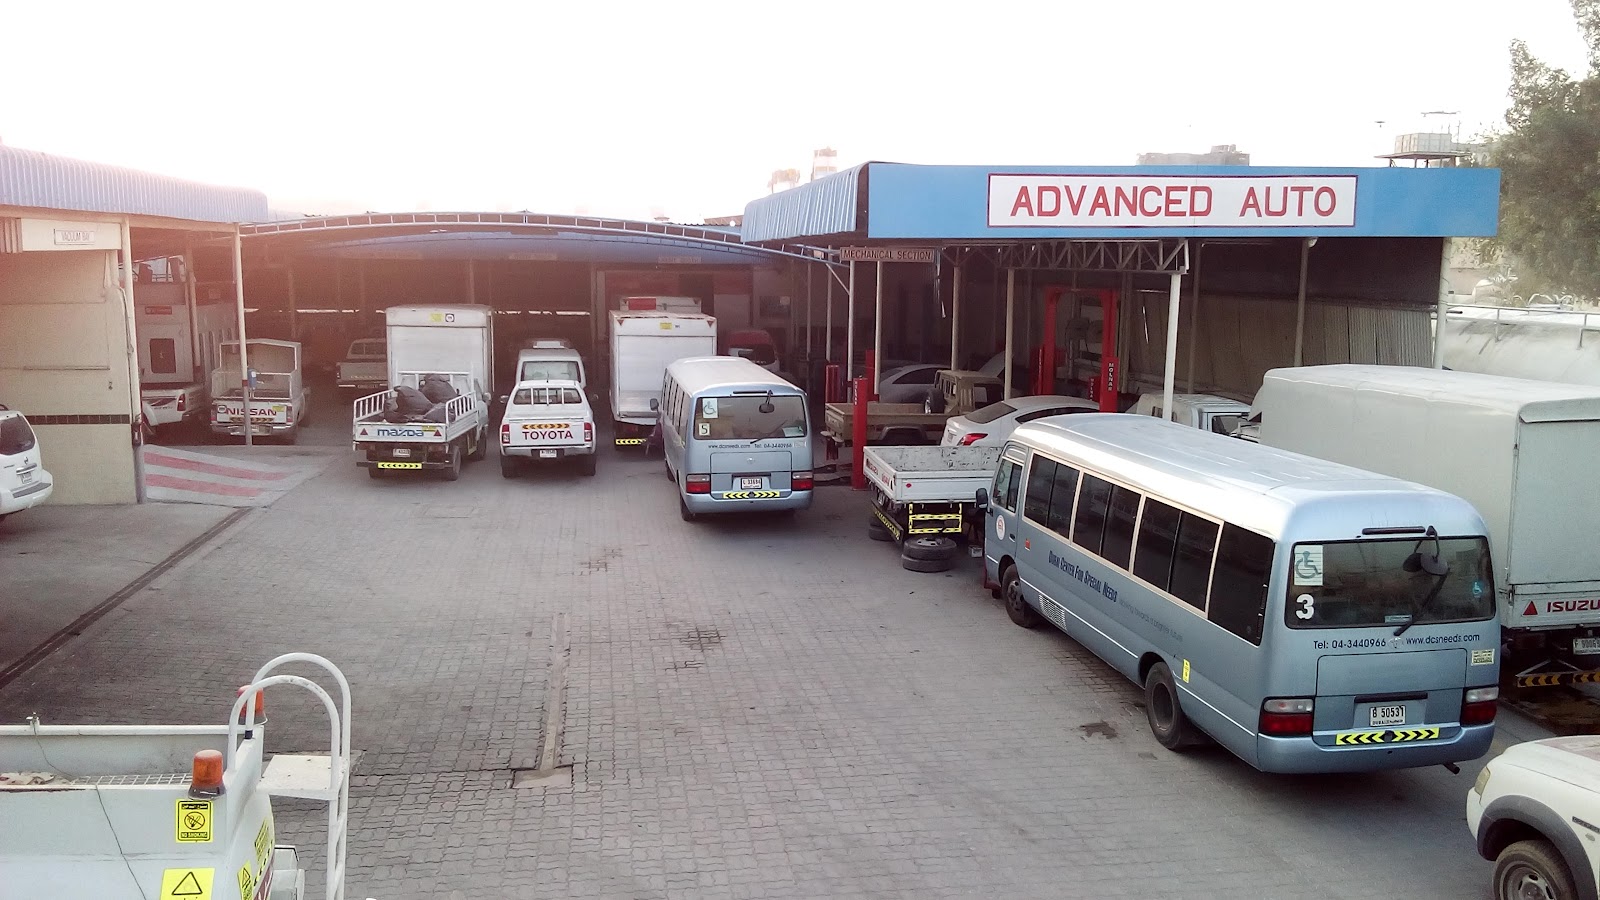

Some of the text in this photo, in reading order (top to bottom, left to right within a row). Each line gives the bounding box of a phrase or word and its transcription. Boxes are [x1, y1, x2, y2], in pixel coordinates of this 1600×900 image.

[1010, 185, 1336, 218] ADVANCED AUTO
[843, 249, 931, 260] MECHANICAL SECTION
[701, 424, 708, 434] 5
[522, 430, 573, 440] TOYOTA
[1295, 594, 1315, 619] 3
[1546, 600, 1600, 612] ISUZU
[1313, 639, 1387, 650] Tel: 04-3440966
[1406, 634, 1480, 645] www.dcsneeds.com
[1381, 706, 1404, 718] 50531
